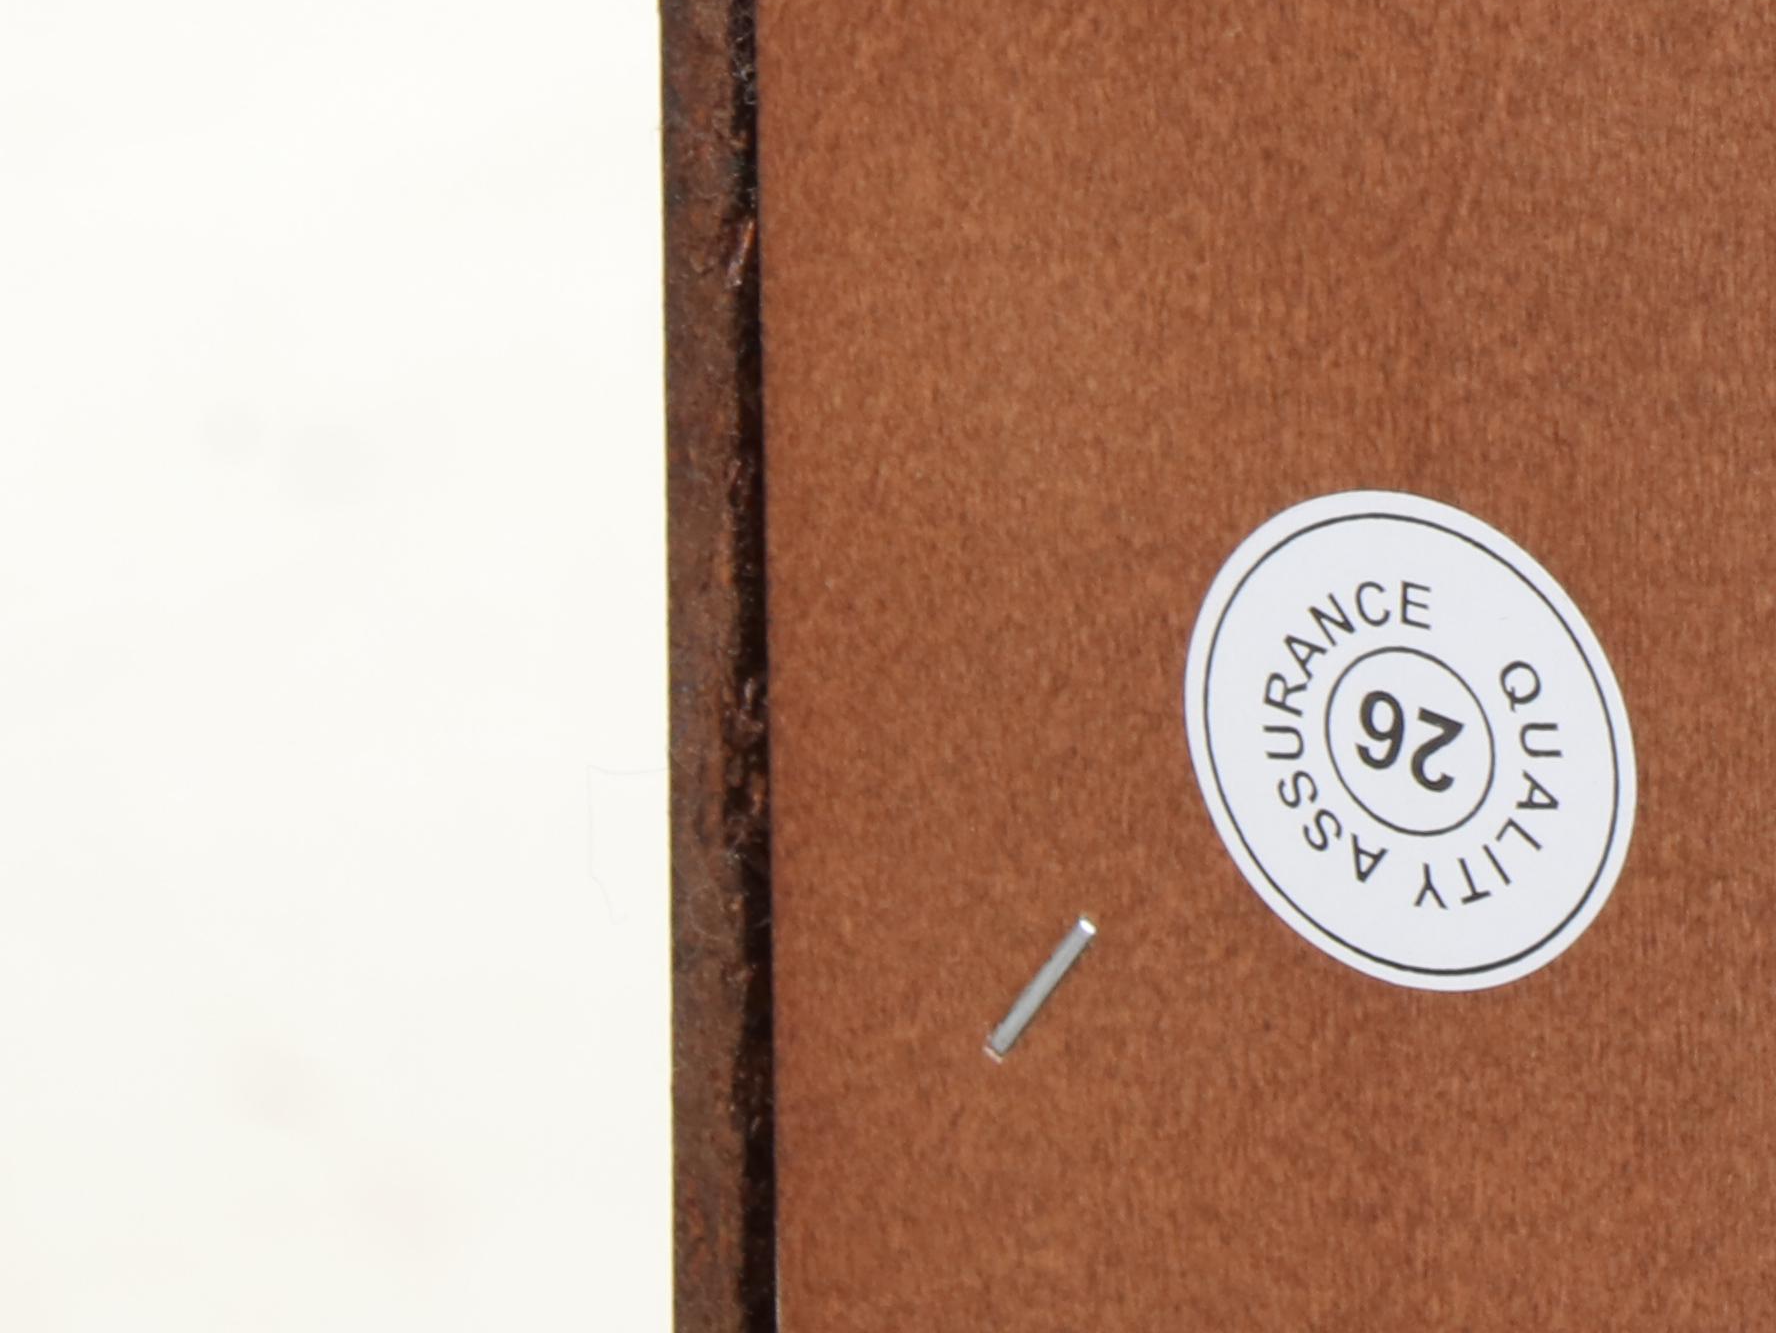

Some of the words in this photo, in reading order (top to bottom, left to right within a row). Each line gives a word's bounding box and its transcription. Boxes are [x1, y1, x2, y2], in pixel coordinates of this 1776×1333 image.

[1262, 580, 1433, 884] ASSURANCE
[1355, 689, 1465, 794] 26
[1413, 659, 1563, 910] QUALITY
